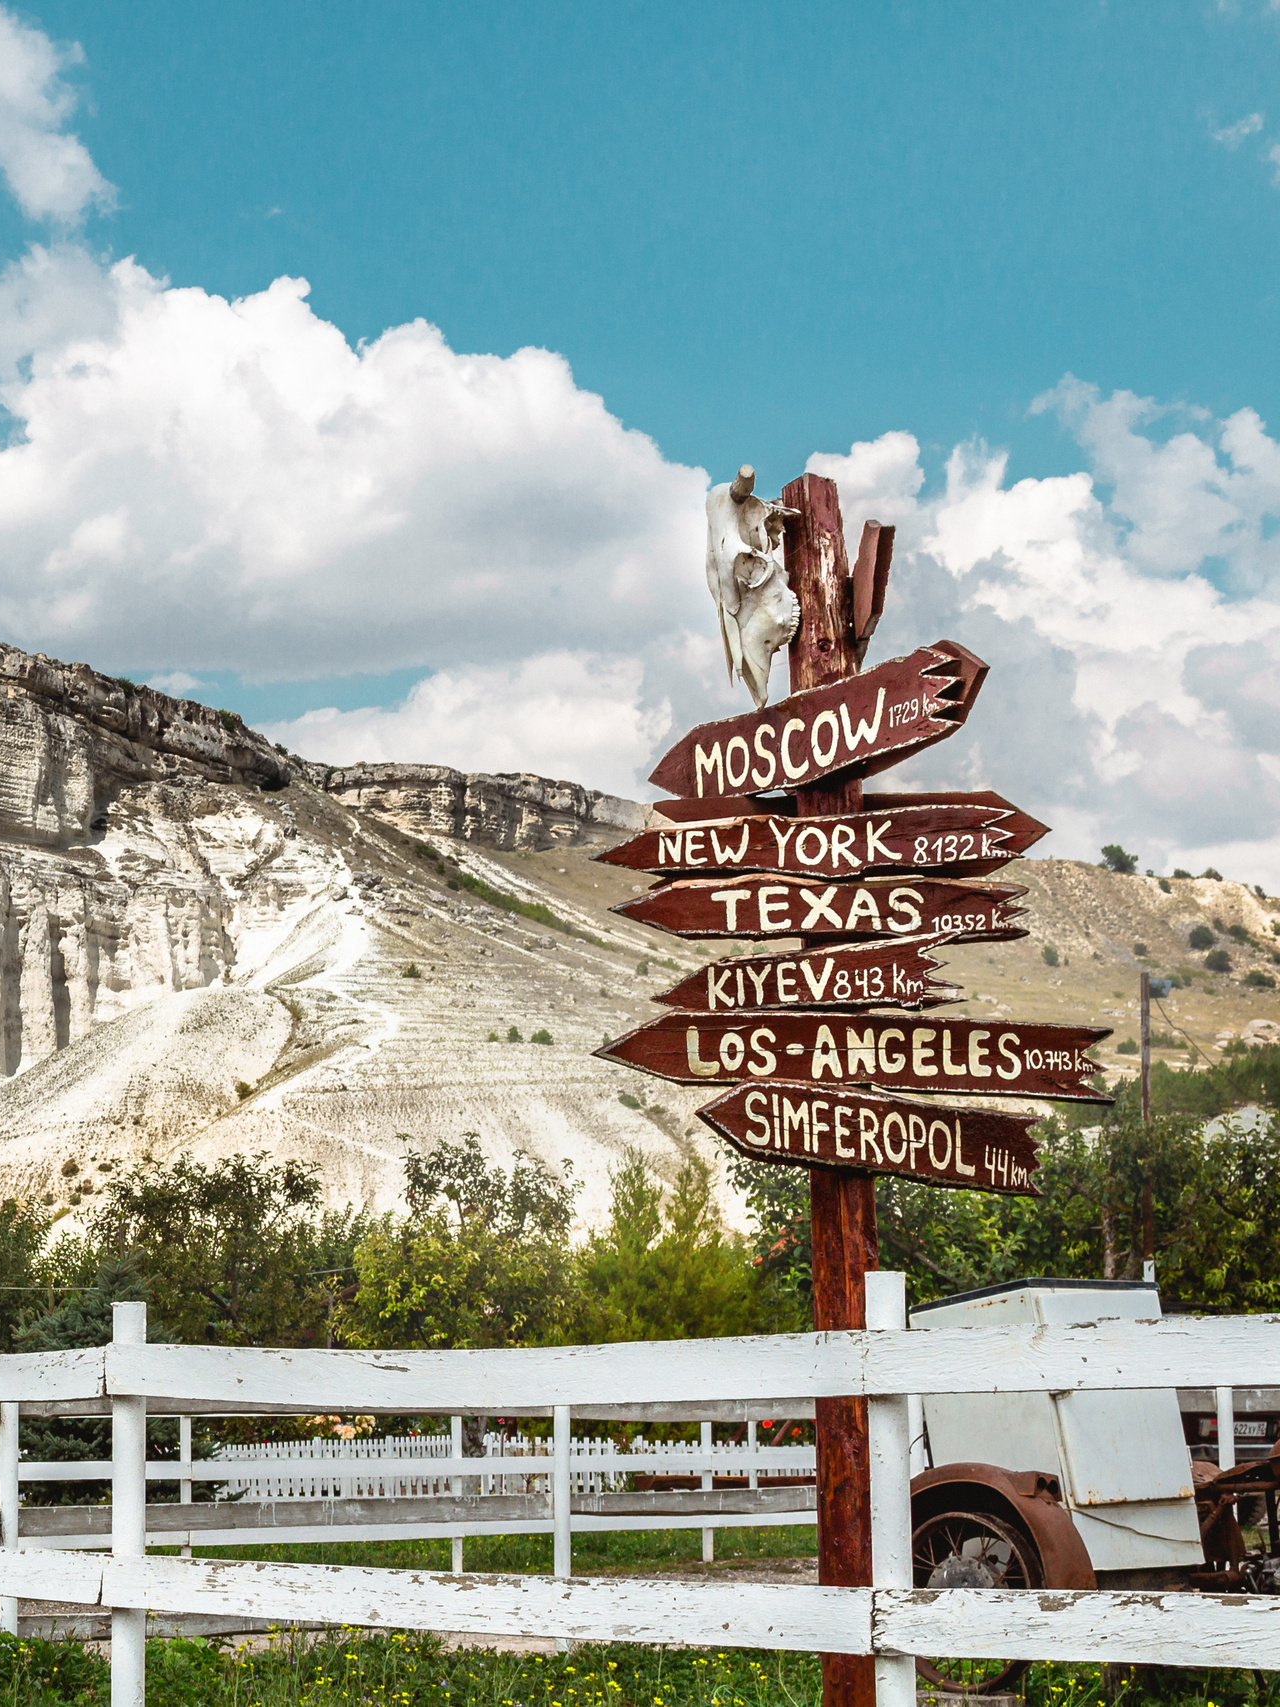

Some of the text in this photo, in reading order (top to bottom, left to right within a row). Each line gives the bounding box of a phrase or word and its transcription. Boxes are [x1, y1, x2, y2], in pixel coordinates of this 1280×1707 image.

[695, 687, 886, 798] MOSCOW
[888, 698, 919, 728] 1729
[658, 824, 749, 865] NEW
[769, 819, 902, 868] YORK
[913, 834, 979, 864] 8.132
[711, 886, 924, 933] TEXAS
[707, 957, 835, 1010] KIYEV
[833, 966, 885, 999] 843
[686, 1024, 1022, 1080] LOS-ANGELES
[1023, 1048, 1073, 1072] 10.743
[745, 1091, 976, 1177] SIMFEROPOL
[984, 1144, 1009, 1187] 44
